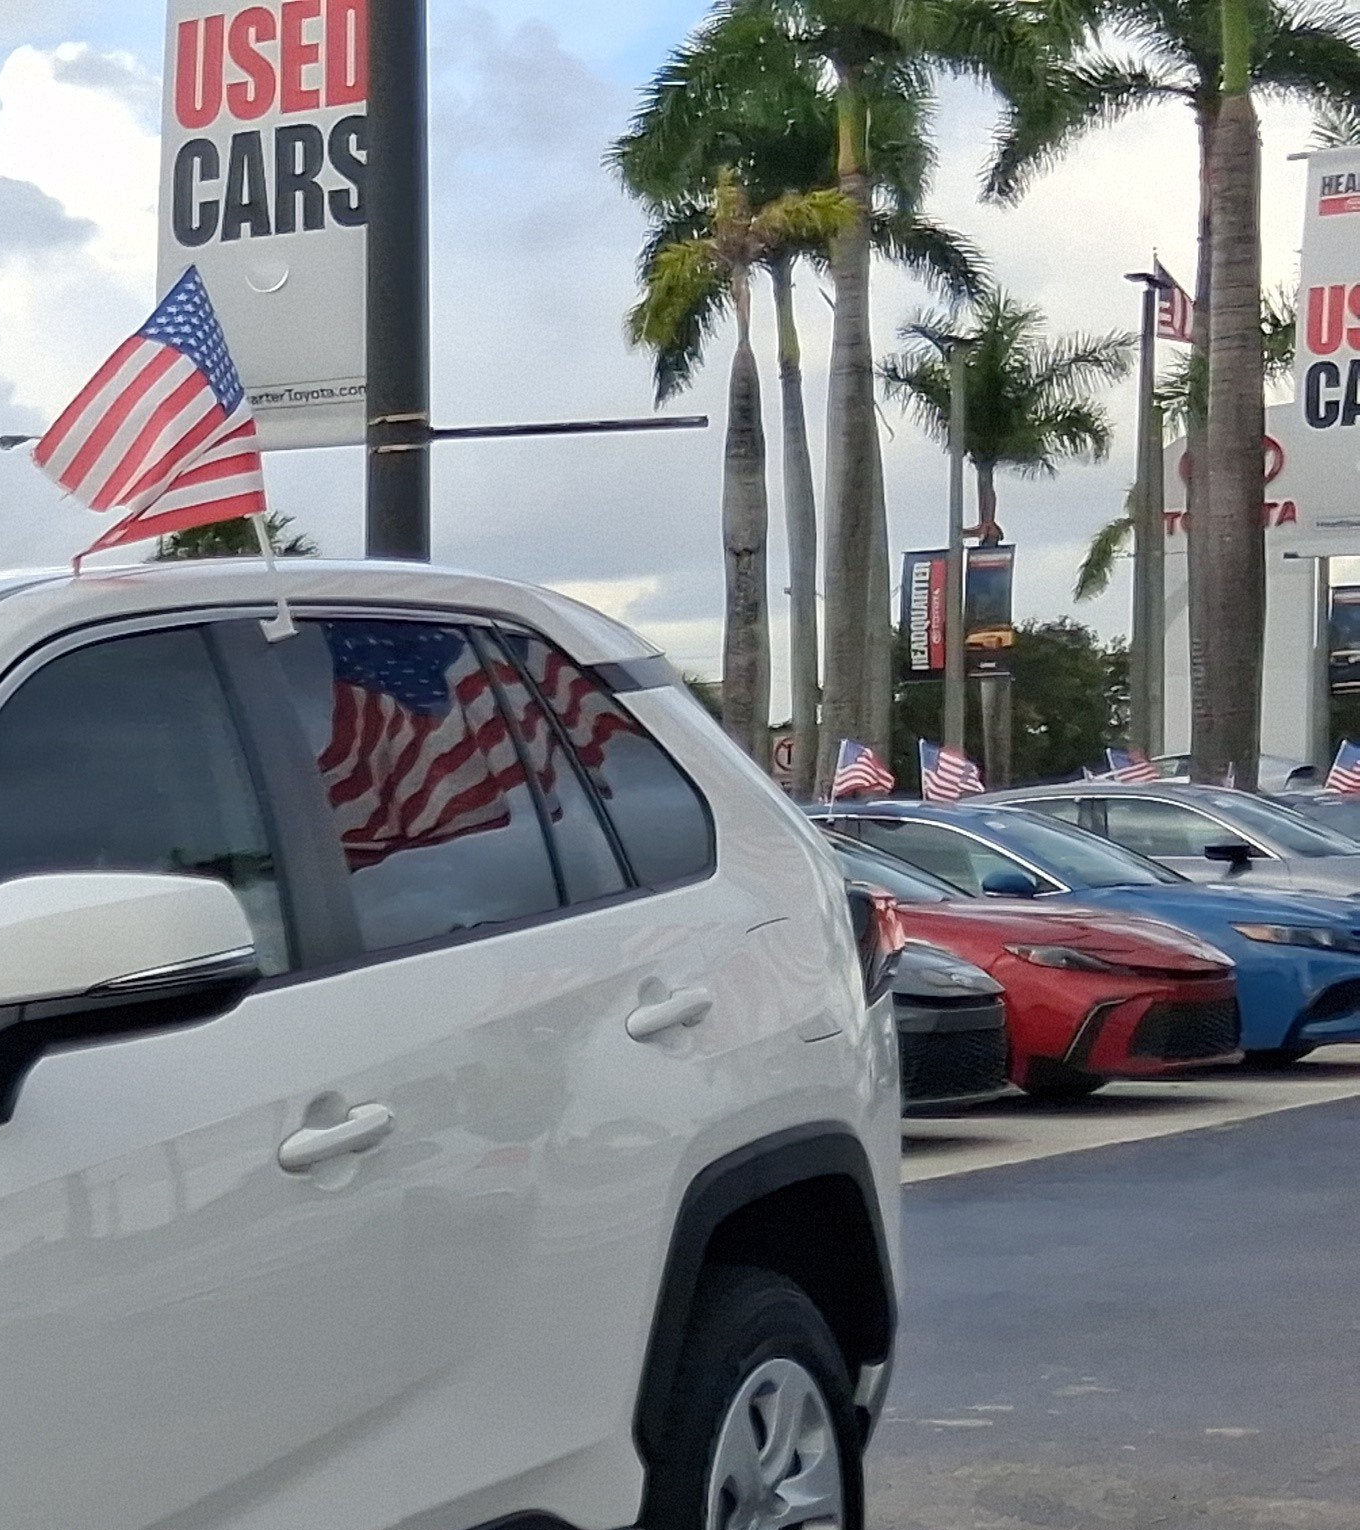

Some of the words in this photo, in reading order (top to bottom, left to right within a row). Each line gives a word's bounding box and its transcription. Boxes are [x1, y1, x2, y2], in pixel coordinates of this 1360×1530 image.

[175, 0, 367, 129] USED
[173, 115, 367, 247] CARS
[1321, 173, 1360, 196] HEA
